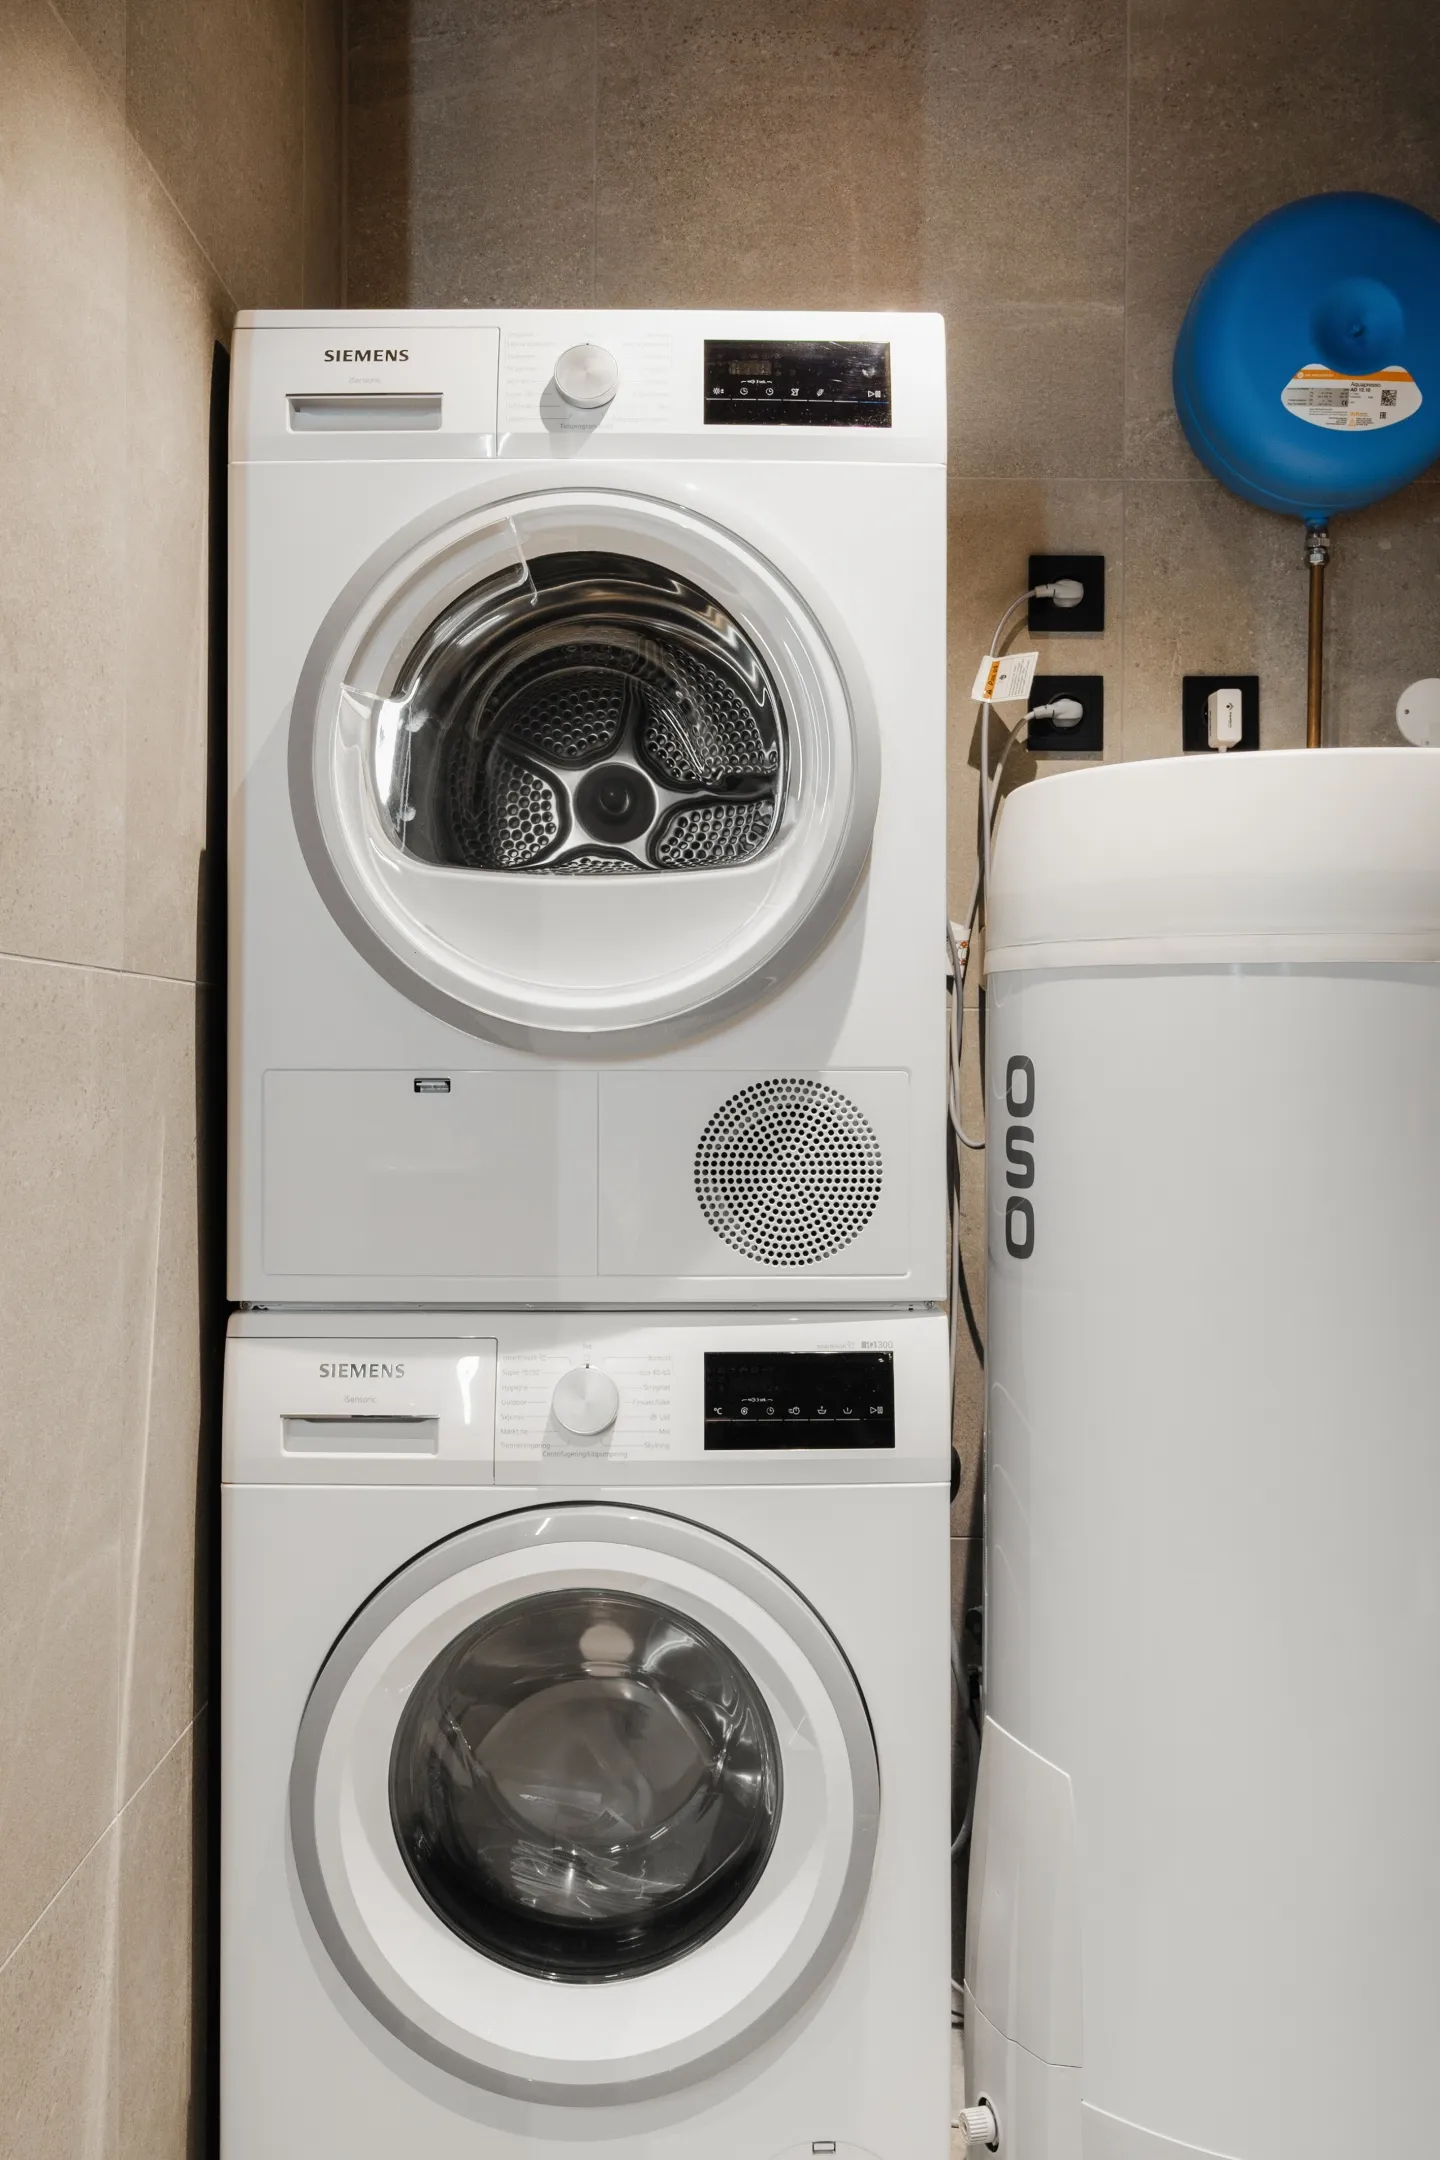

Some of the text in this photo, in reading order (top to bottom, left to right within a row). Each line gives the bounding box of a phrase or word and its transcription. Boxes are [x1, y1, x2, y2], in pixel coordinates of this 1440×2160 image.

[324, 349, 409, 362] SIEMENS
[1005, 1054, 1035, 1260] OSO
[319, 1363, 405, 1378] SIEMENS
